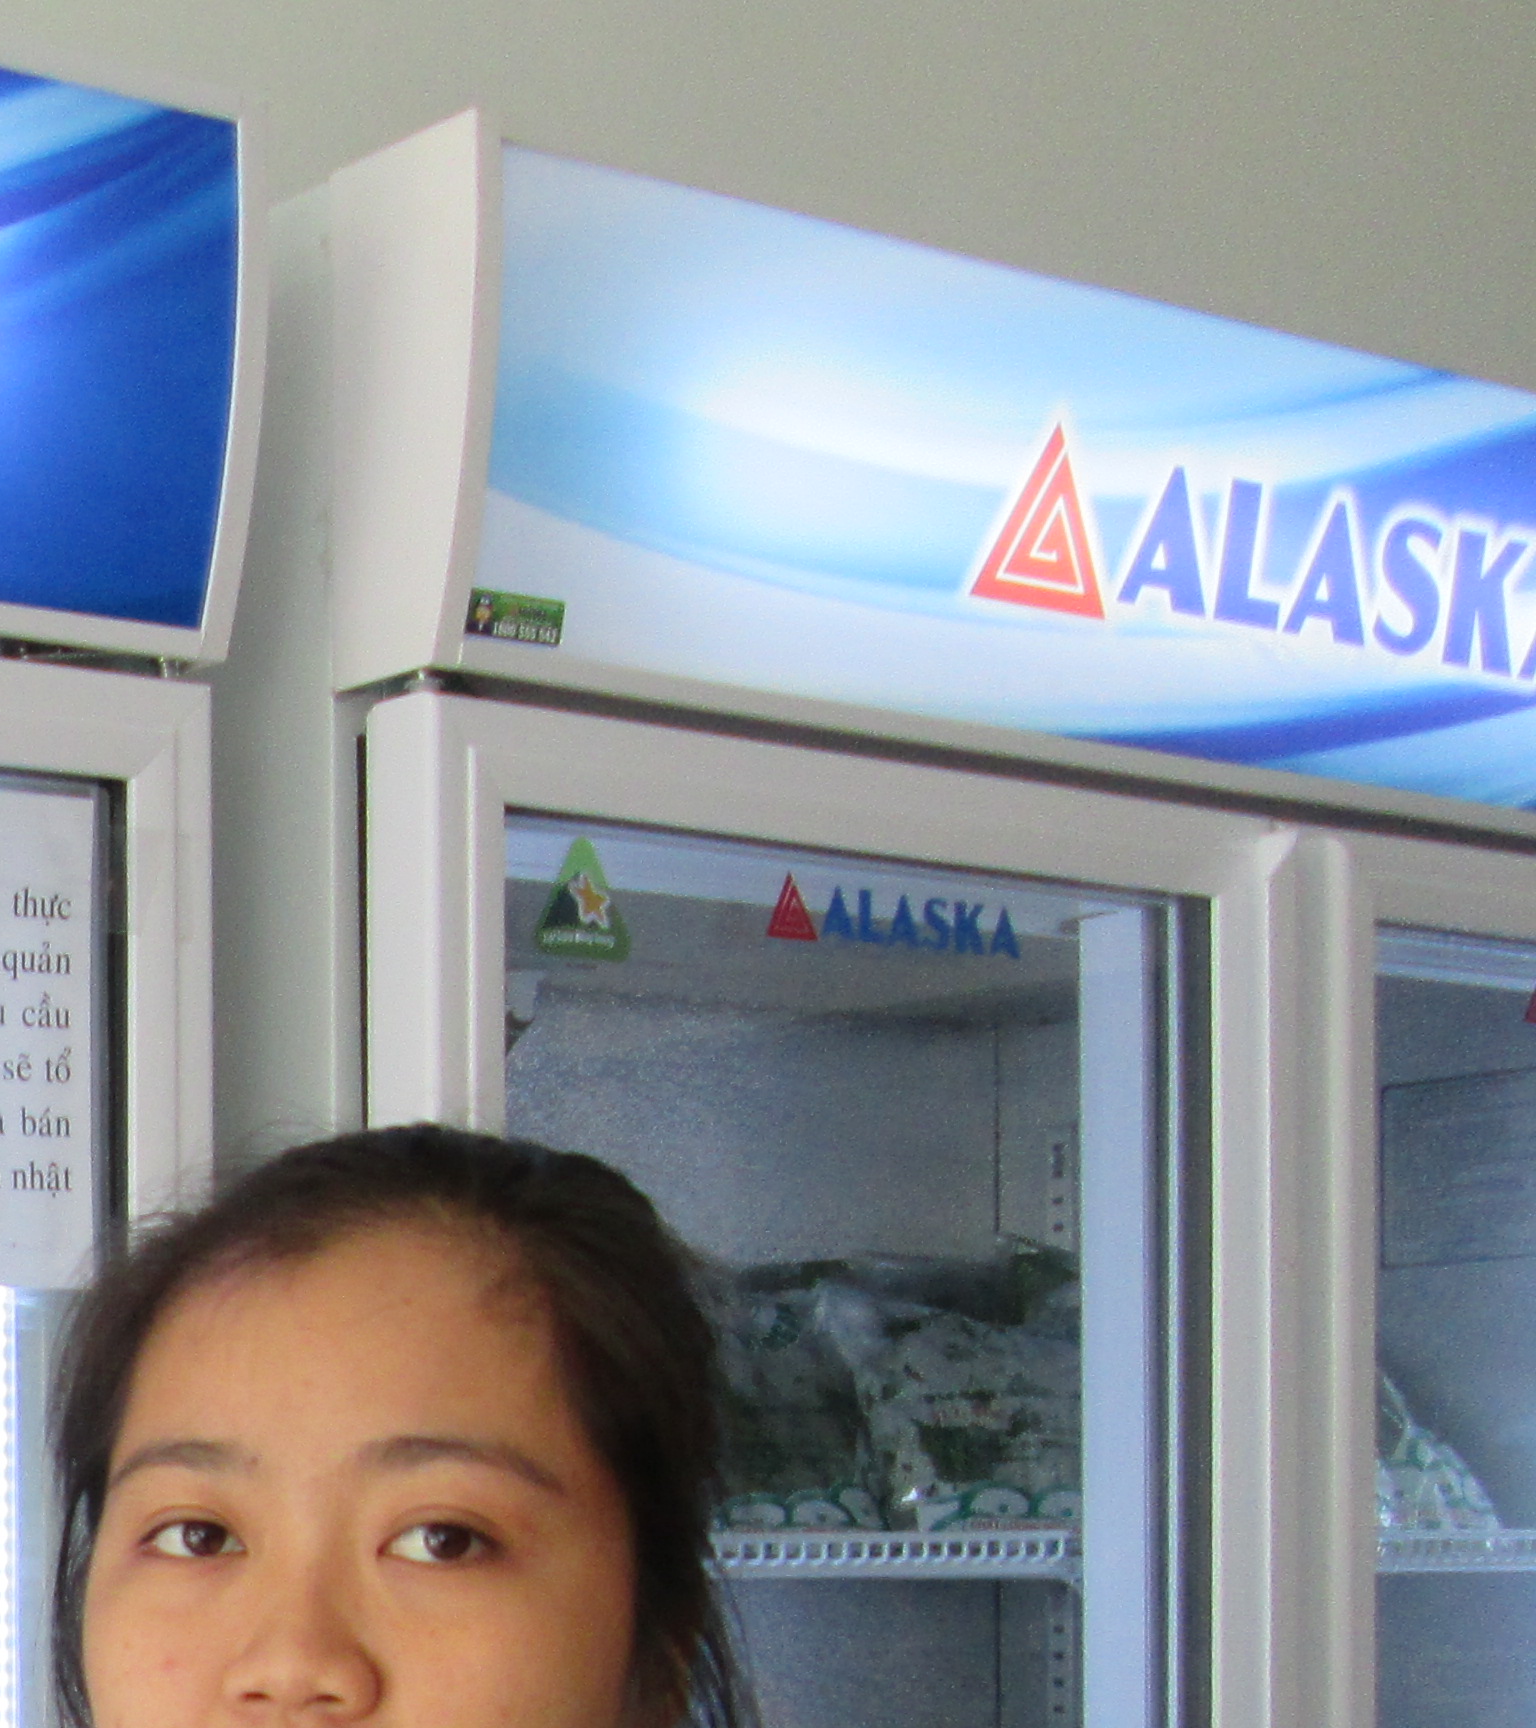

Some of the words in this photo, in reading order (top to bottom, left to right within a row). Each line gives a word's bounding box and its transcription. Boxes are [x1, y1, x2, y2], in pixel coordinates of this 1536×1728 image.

[1116, 465, 1536, 680] ALASK
[13, 888, 71, 925] thực
[822, 885, 1020, 959] ALASKA
[1, 943, 71, 980] quản
[21, 993, 70, 1029] cầu
[2, 1055, 32, 1081] sẽ
[45, 1048, 72, 1082] tổ
[21, 1107, 71, 1137] bán
[12, 1162, 71, 1197] nhật
